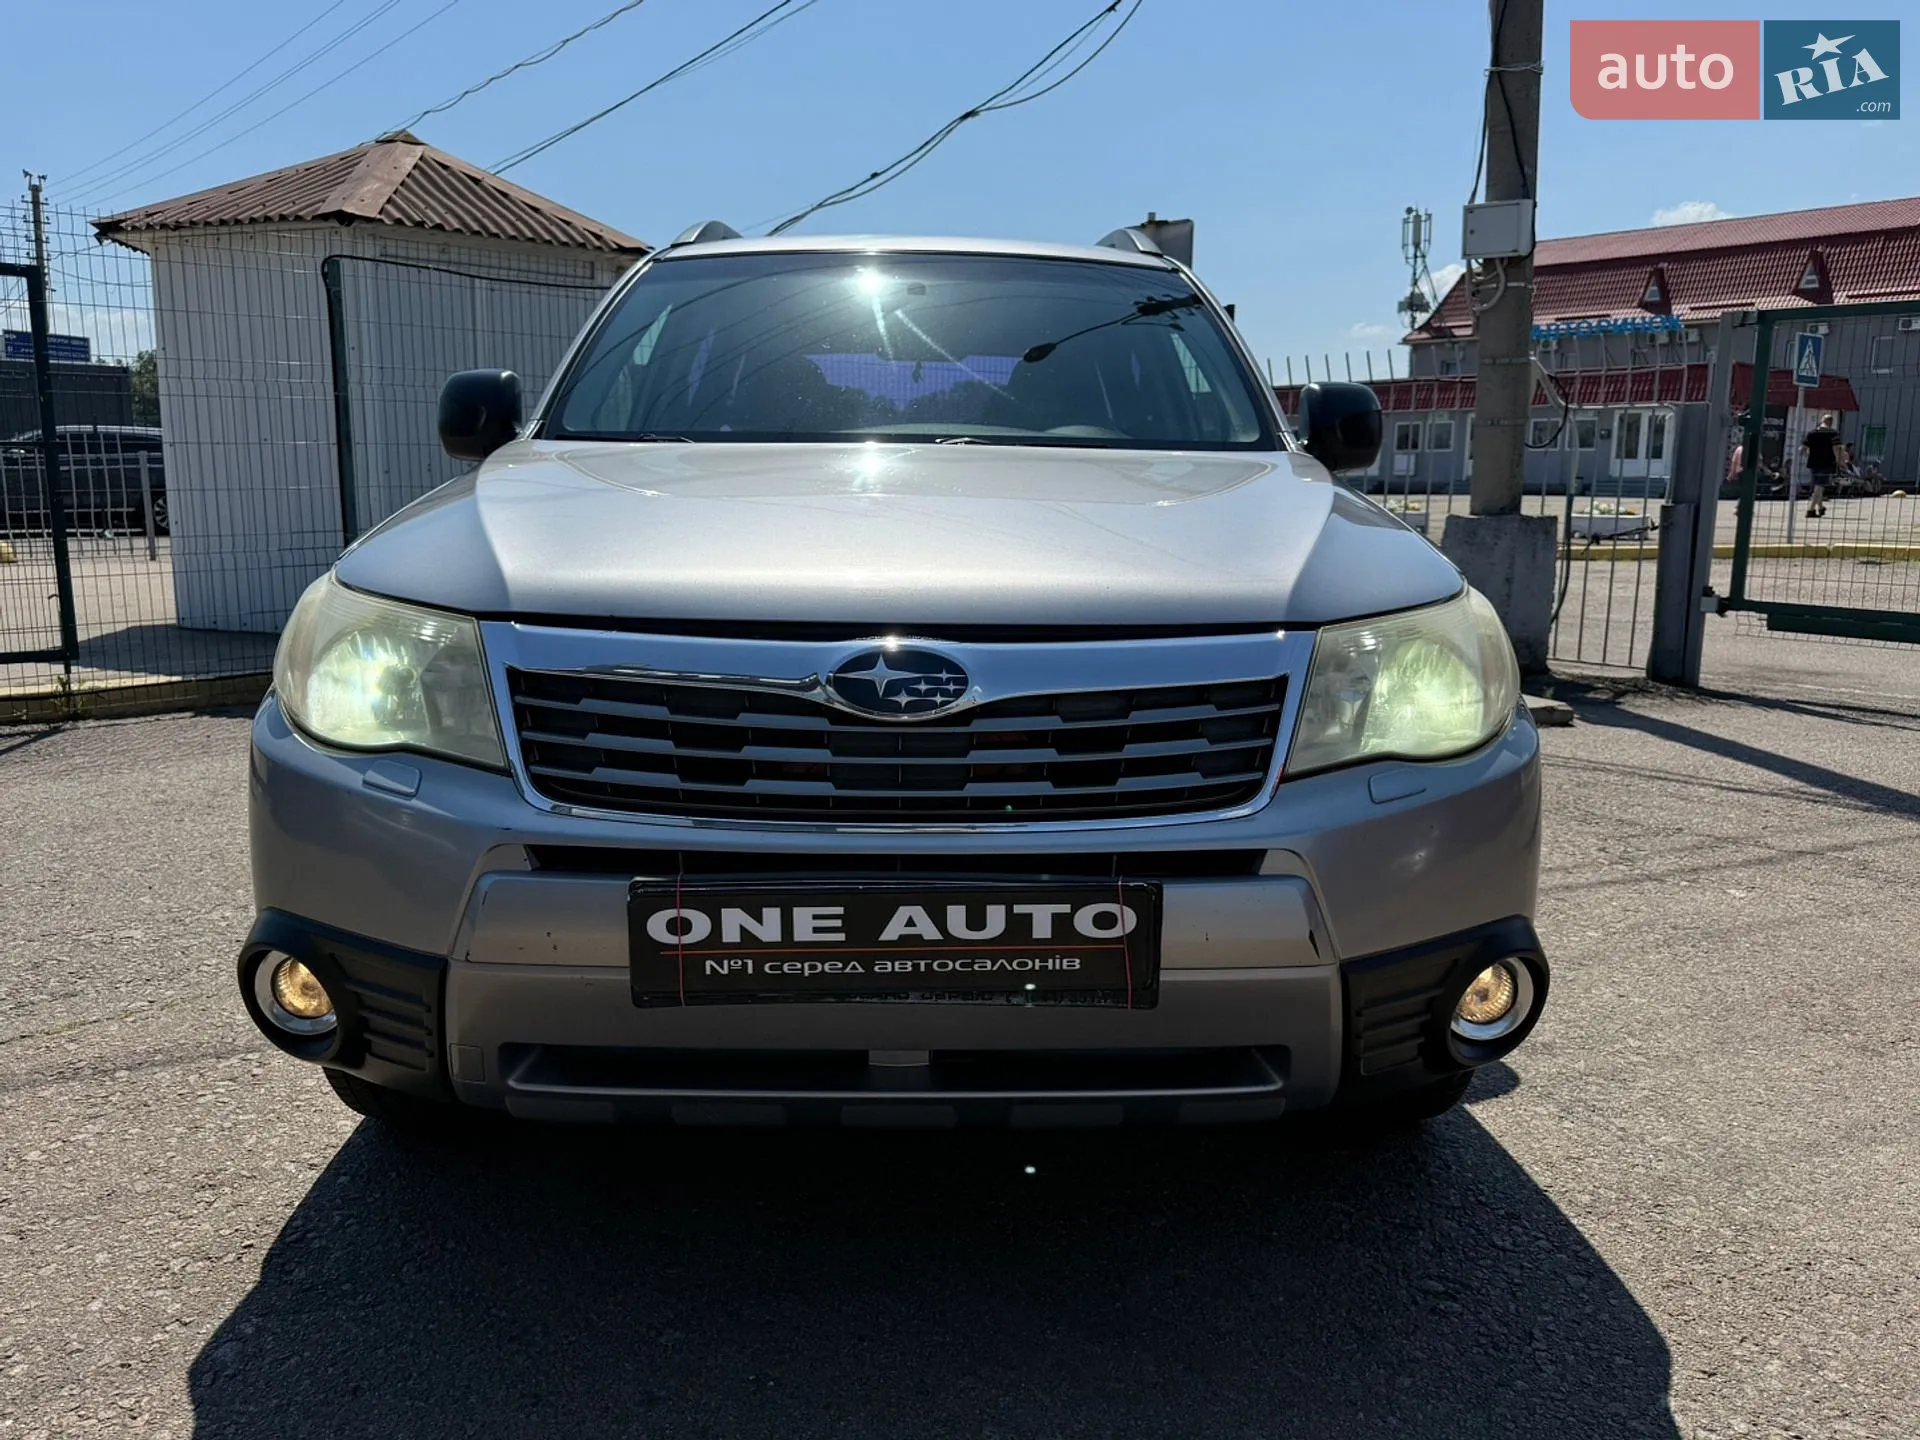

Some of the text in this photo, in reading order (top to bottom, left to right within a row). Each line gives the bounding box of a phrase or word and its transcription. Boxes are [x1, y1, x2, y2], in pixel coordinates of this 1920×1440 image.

[646, 902, 1137, 945] ONE AUTO
[763, 960, 865, 976] серед
[873, 953, 1081, 973] автосалонів
